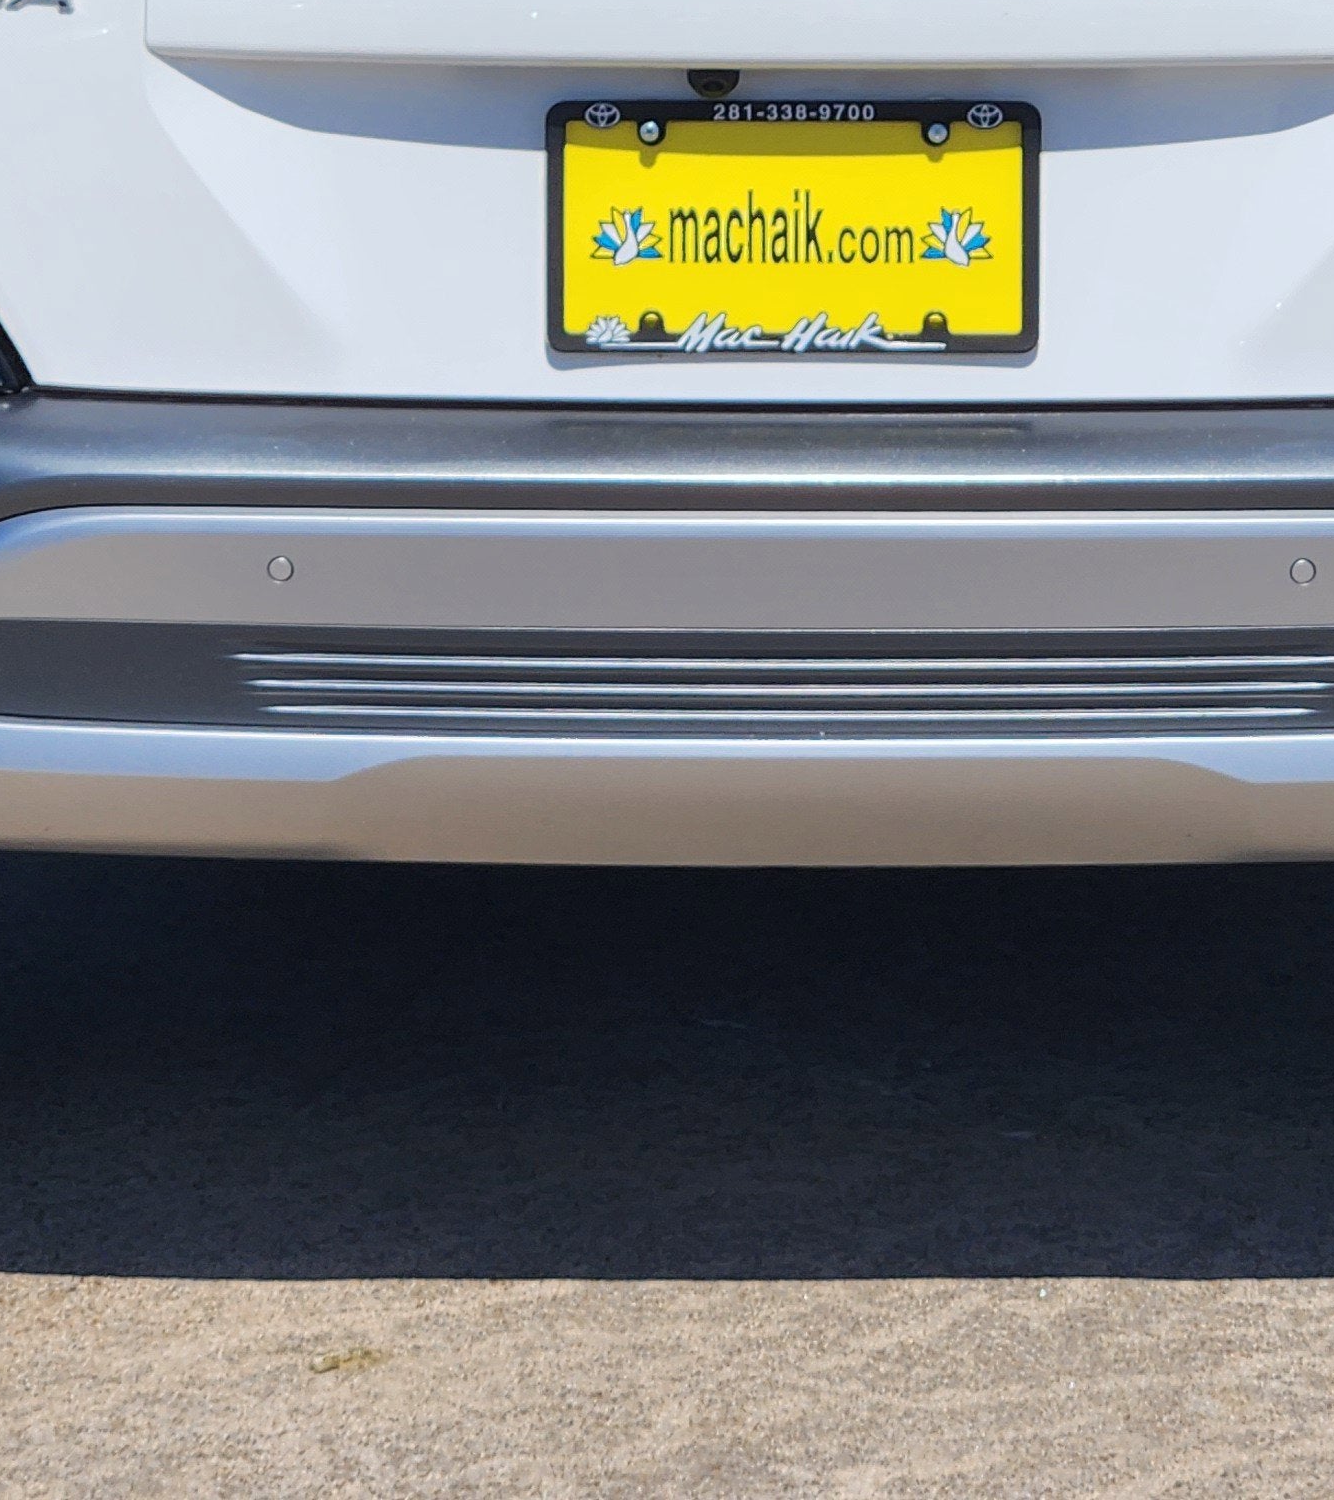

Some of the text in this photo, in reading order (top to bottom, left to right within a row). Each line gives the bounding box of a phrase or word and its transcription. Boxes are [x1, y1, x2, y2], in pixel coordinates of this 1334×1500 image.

[713, 103, 875, 120] 281-338-9700
[669, 189, 915, 264] machaik.com
[677, 311, 899, 353] Mac Haik
